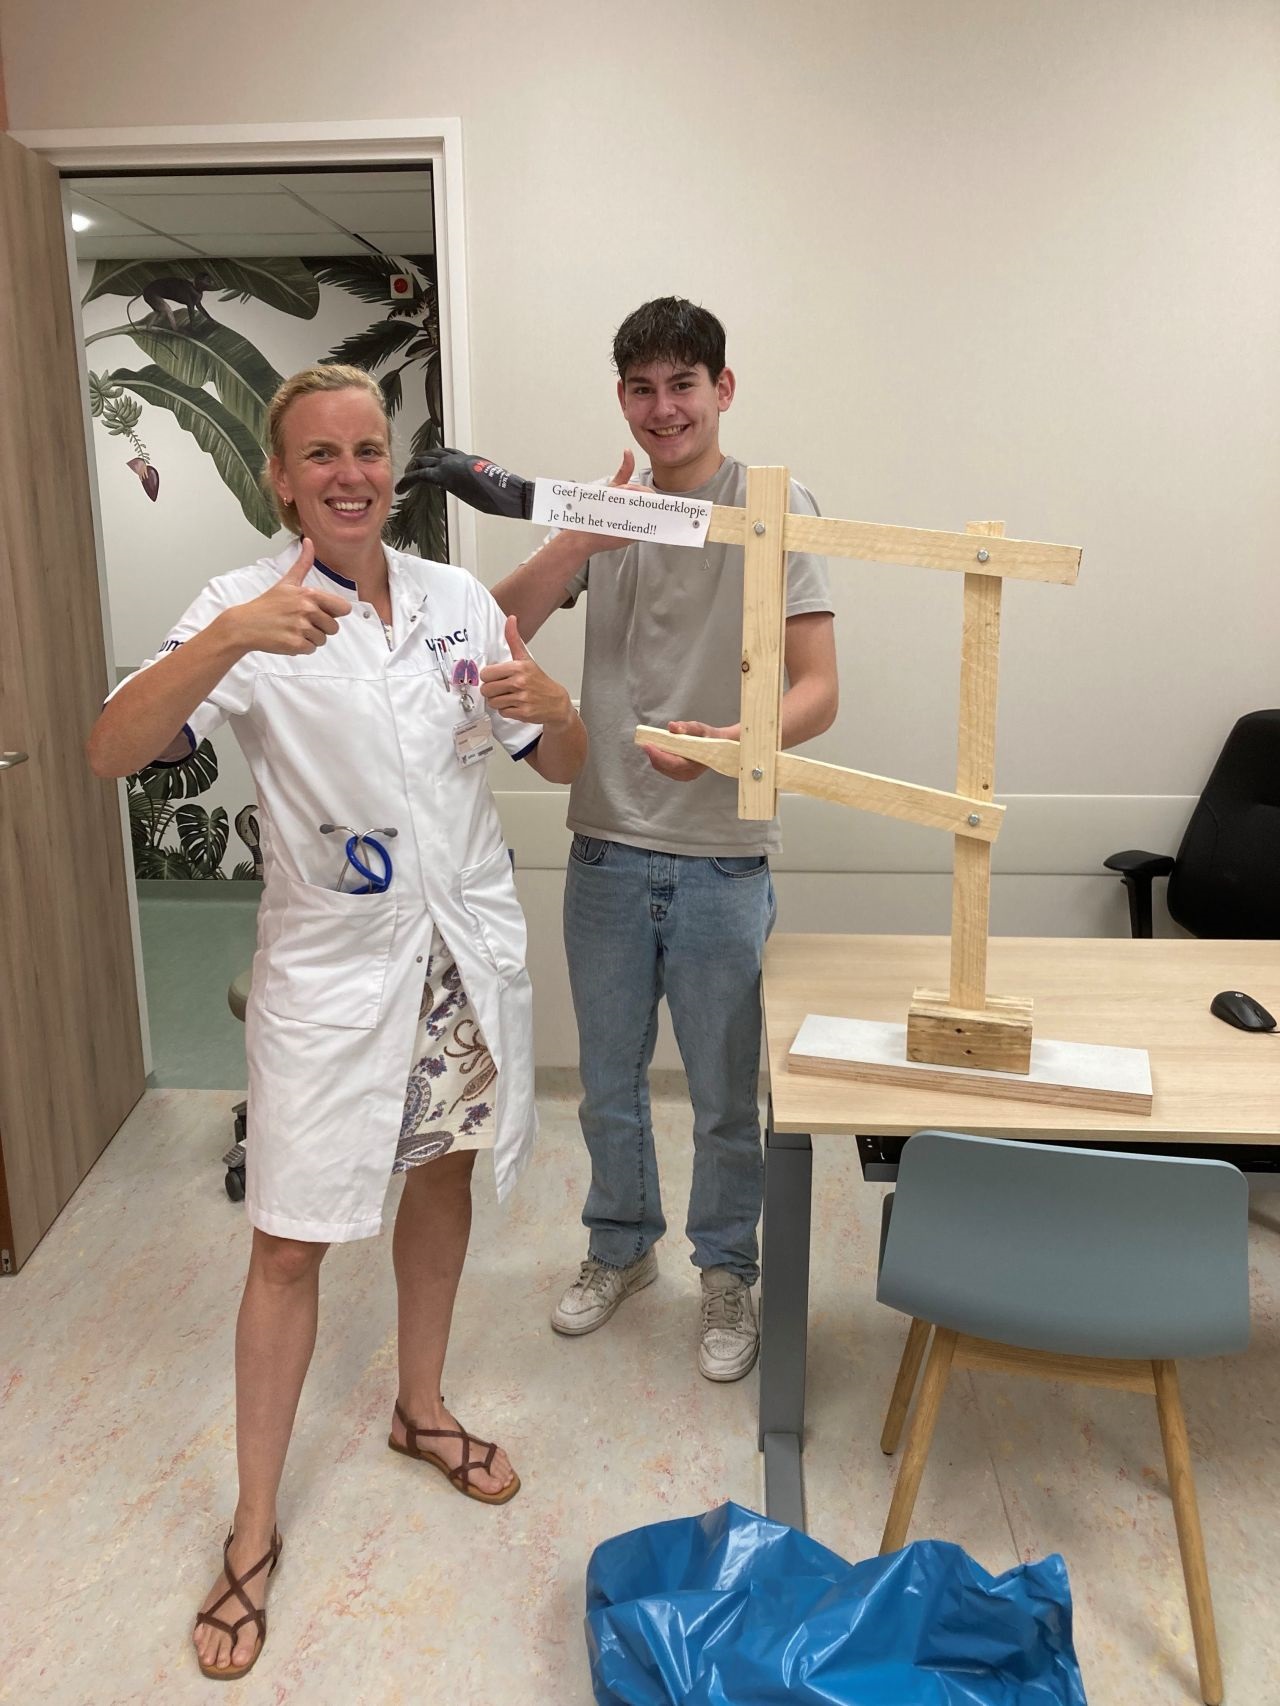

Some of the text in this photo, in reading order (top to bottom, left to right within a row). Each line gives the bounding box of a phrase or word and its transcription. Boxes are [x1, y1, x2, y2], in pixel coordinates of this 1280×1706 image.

[552, 484, 708, 518] Geef jezelf een schouderklopje.
[548, 509, 657, 535] Je hebt het verdiend!!
